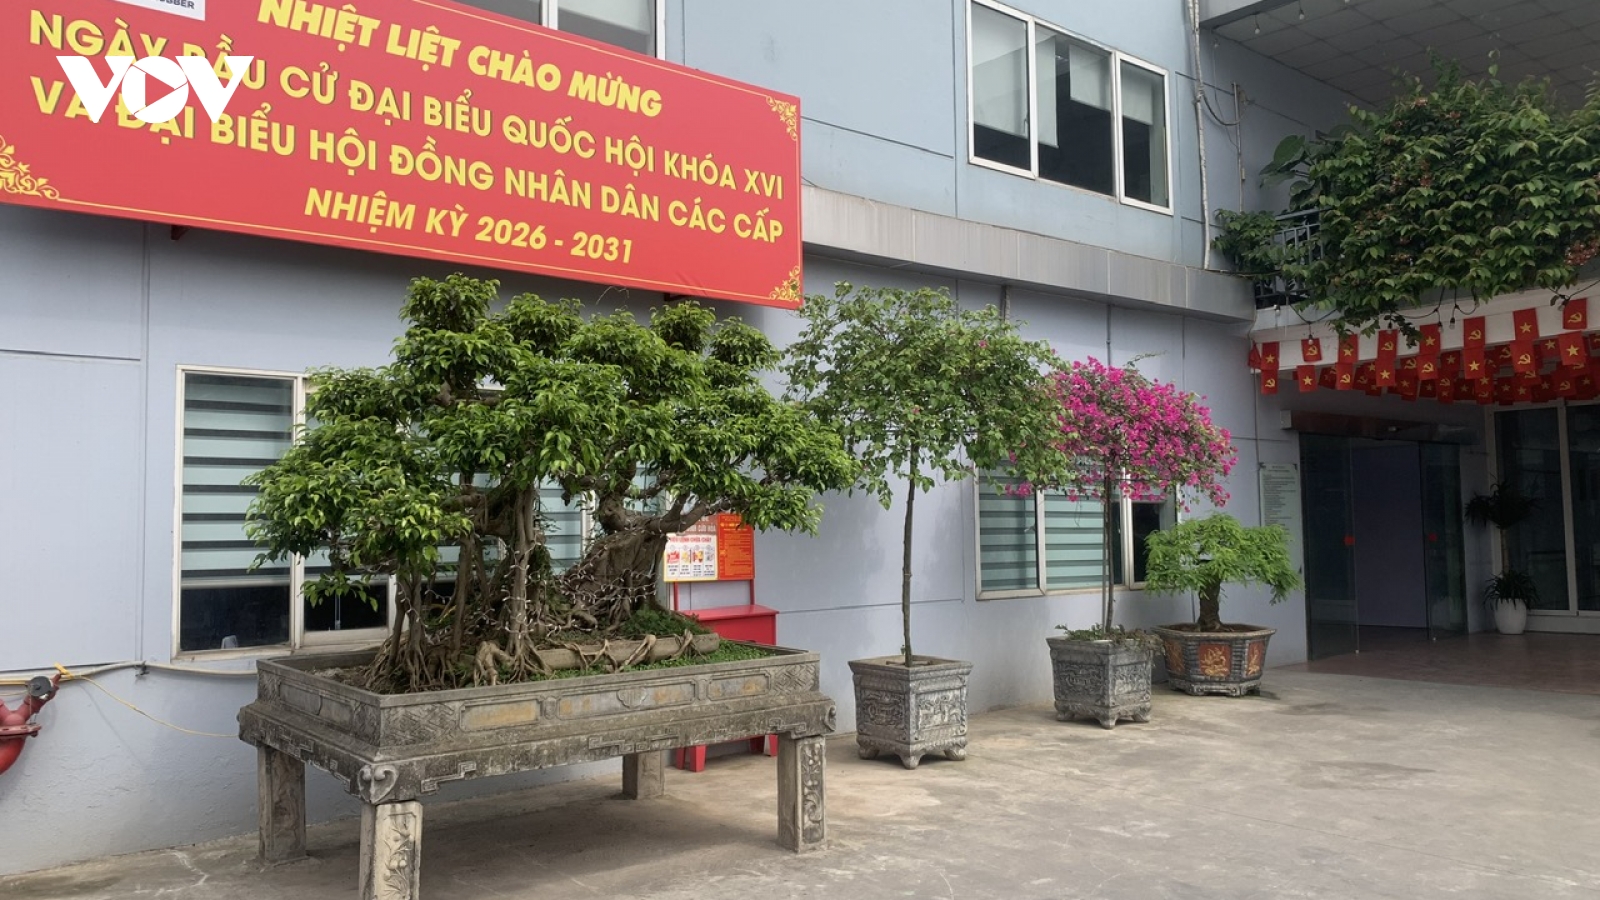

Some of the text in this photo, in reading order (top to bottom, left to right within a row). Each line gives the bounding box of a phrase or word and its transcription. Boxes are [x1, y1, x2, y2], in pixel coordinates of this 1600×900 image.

[258, 0, 662, 117] NHIỆT LIỆT CHÀO MỪNG
[210, 102, 295, 156] BIỂU
[309, 128, 377, 176] HỘI
[389, 136, 495, 191] ĐỒNG
[504, 167, 591, 209] NHÂN
[601, 183, 660, 221] DÂN
[668, 197, 726, 234] CÁC
[733, 208, 783, 243] CẤP
[279, 62, 339, 105] CỬ
[348, 79, 411, 126] ĐẠI
[423, 89, 491, 137] BIỂU
[502, 115, 595, 159] QUỐC
[605, 135, 654, 177] HỘI
[664, 151, 737, 189] KHÓA
[745, 168, 783, 199] XVI
[304, 187, 632, 264] NHIỆM KỲ 2026 - 2031
